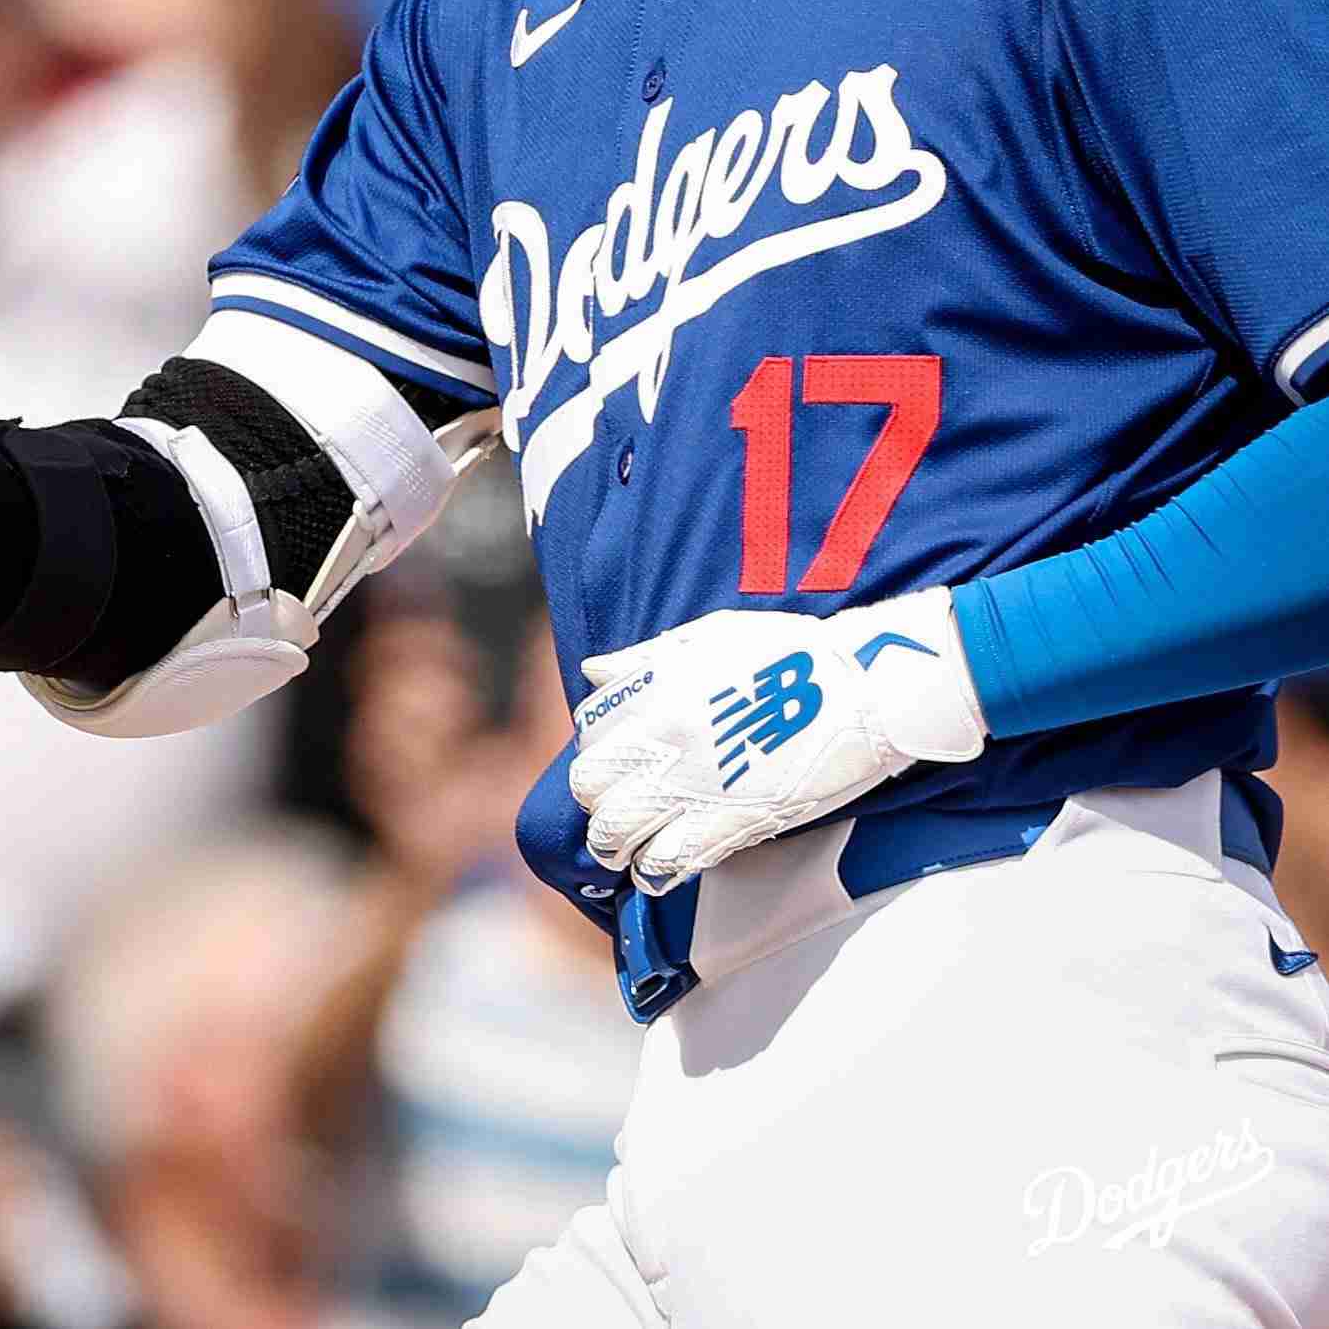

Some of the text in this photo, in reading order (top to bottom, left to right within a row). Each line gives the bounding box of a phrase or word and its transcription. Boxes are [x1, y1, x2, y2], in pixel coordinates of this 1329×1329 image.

[479, 63, 947, 537] Dodgers
[730, 355, 943, 594] 17
[584, 670, 655, 726] balance
